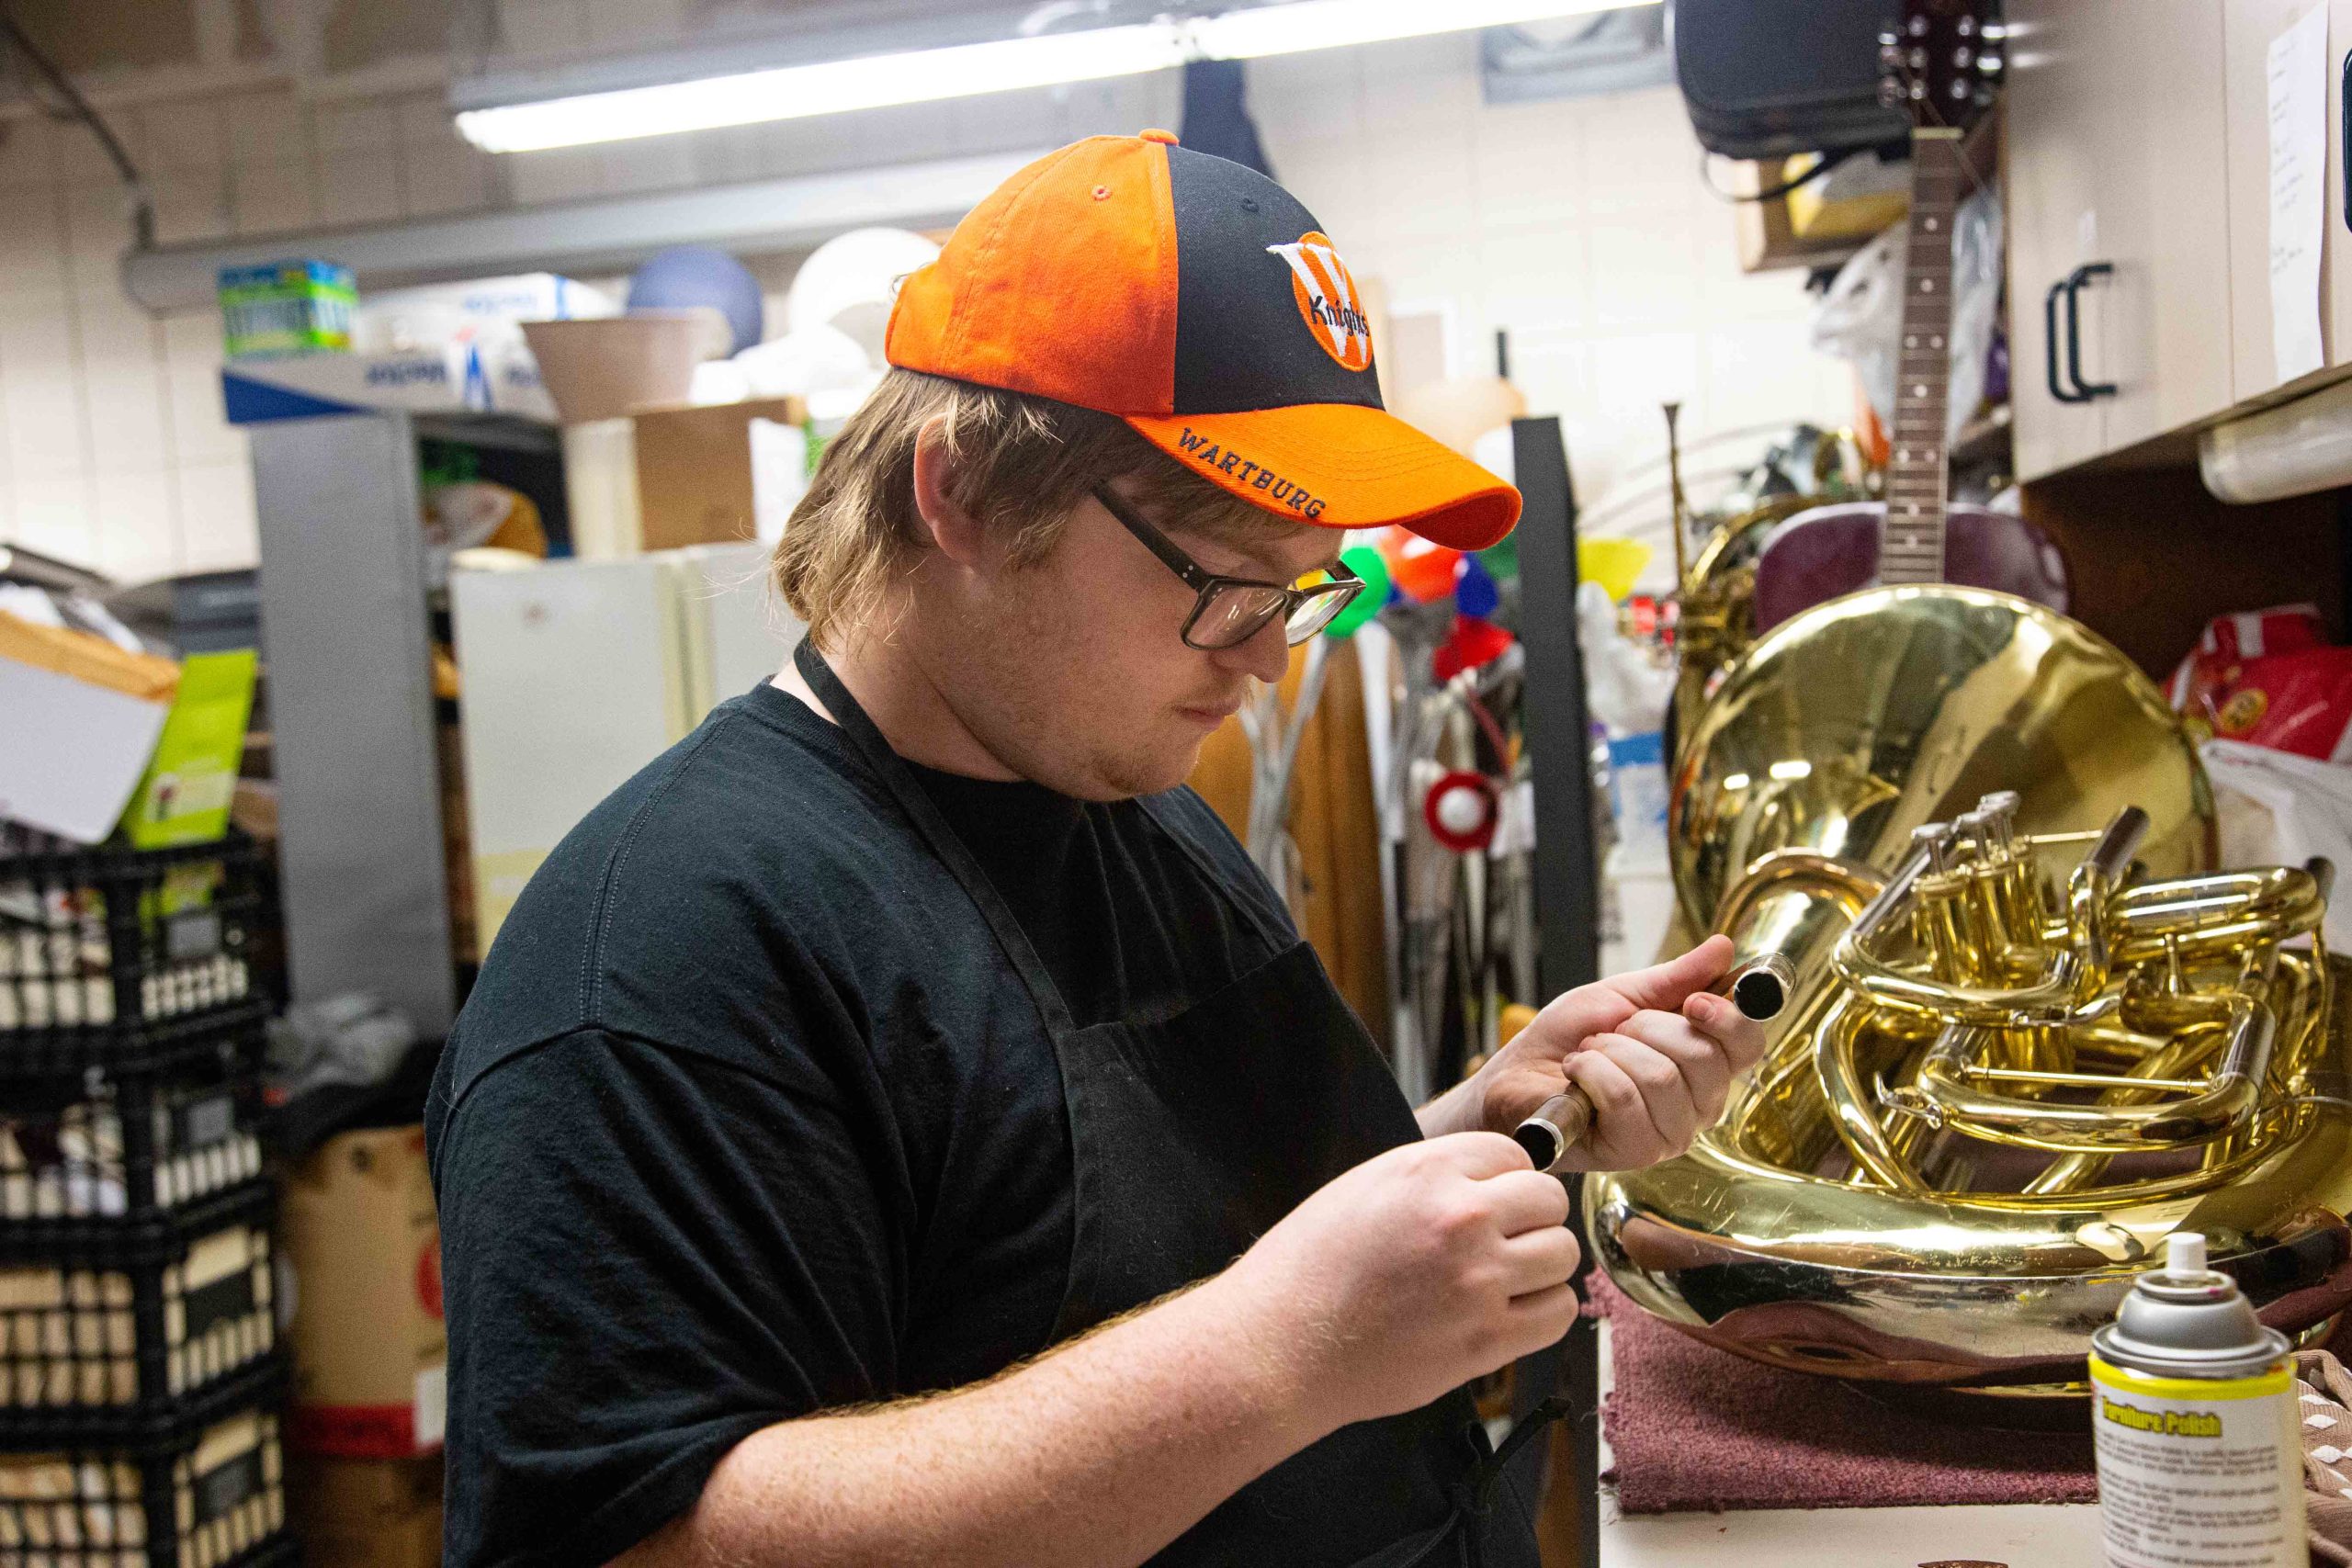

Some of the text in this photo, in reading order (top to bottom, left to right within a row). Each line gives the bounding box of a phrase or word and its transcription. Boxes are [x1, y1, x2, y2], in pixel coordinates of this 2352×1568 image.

[1308, 295, 1370, 337] Knights
[1179, 427, 1327, 518] WARTBURG
[2102, 1394, 2222, 1438] Furniture Polish
